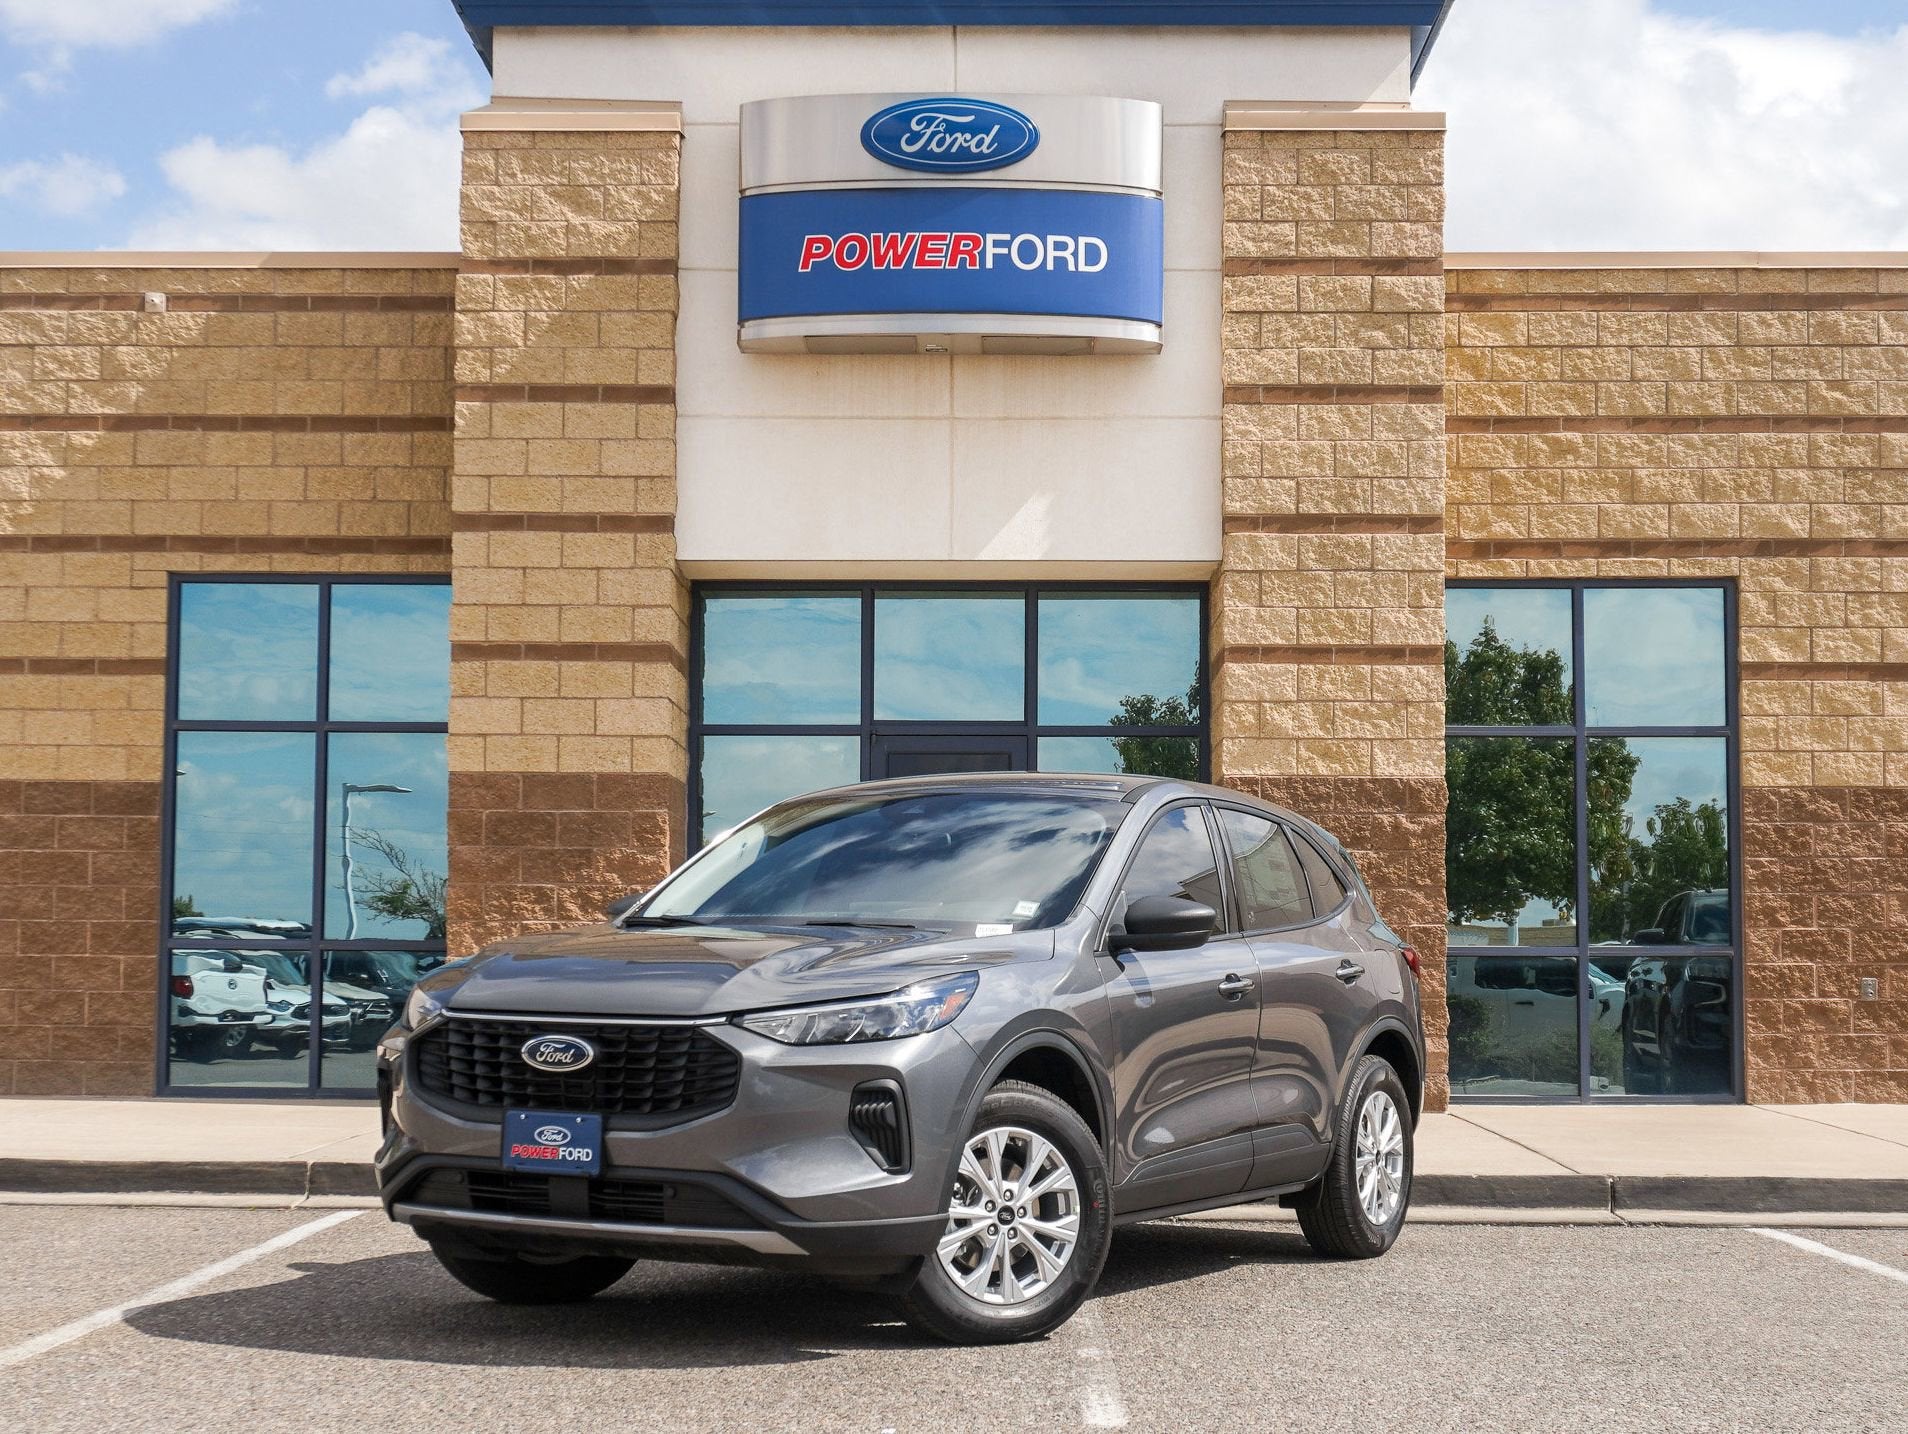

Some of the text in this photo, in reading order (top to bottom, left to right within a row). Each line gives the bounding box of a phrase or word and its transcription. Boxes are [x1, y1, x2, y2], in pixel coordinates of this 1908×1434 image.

[900, 112, 1000, 154] Ford
[535, 1042, 575, 1063] Ford
[541, 1129, 564, 1142] Ford
